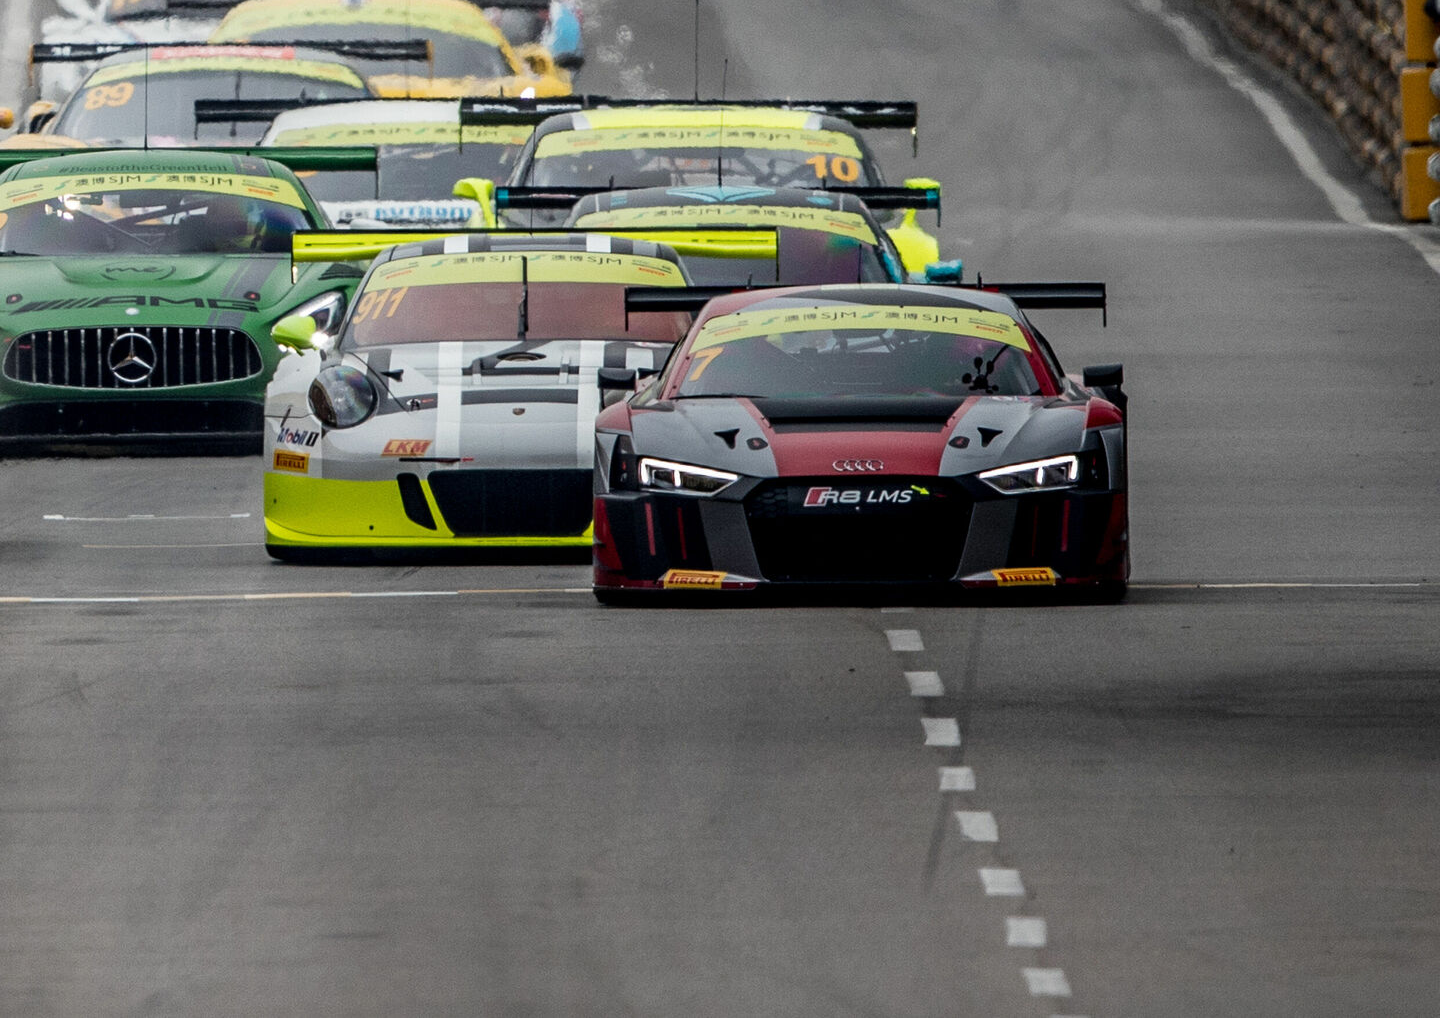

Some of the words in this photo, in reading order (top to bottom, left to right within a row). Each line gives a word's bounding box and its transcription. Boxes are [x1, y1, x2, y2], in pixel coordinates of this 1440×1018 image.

[84, 81, 136, 110] 89
[805, 154, 860, 182] 10
[108, 174, 141, 185] SJM
[199, 175, 233, 186] SJM
[586, 255, 622, 265] SJM
[352, 285, 410, 325] 911
[821, 311, 857, 321] SJM
[921, 312, 958, 324] SJM
[688, 346, 725, 382] 7
[276, 427, 306, 445] Mobil
[382, 439, 432, 455] LKM
[275, 453, 306, 471] PIRELLI
[816, 489, 861, 504] R8
[866, 489, 913, 503] LMS
[668, 572, 721, 586] PIRELLI
[998, 569, 1051, 584] PIRELLI
